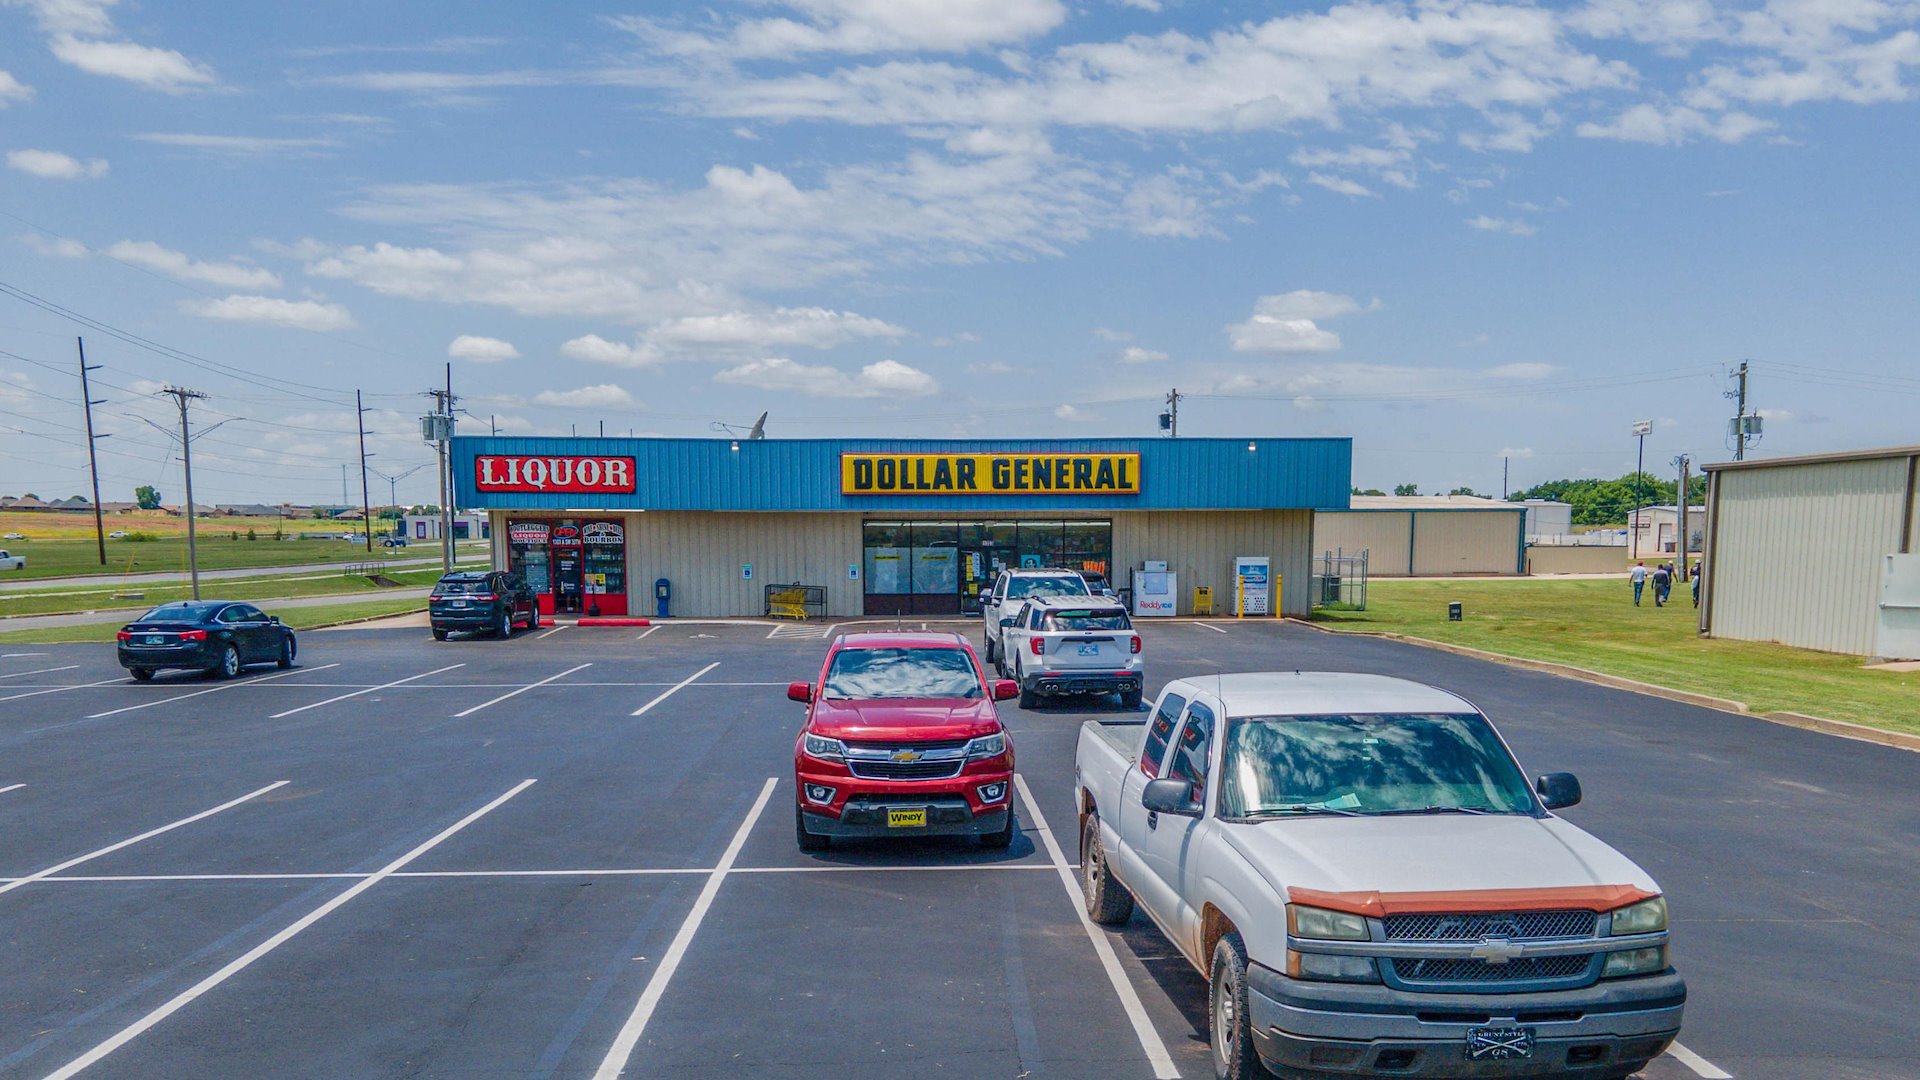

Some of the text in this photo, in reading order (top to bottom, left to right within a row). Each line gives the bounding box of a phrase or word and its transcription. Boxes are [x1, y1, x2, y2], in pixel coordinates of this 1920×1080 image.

[480, 458, 630, 490] LIQUOR
[853, 457, 1133, 490] DOLLAR GENERAL
[553, 527, 577, 537] OPEN
[1491, 1048, 1508, 1056] GS
